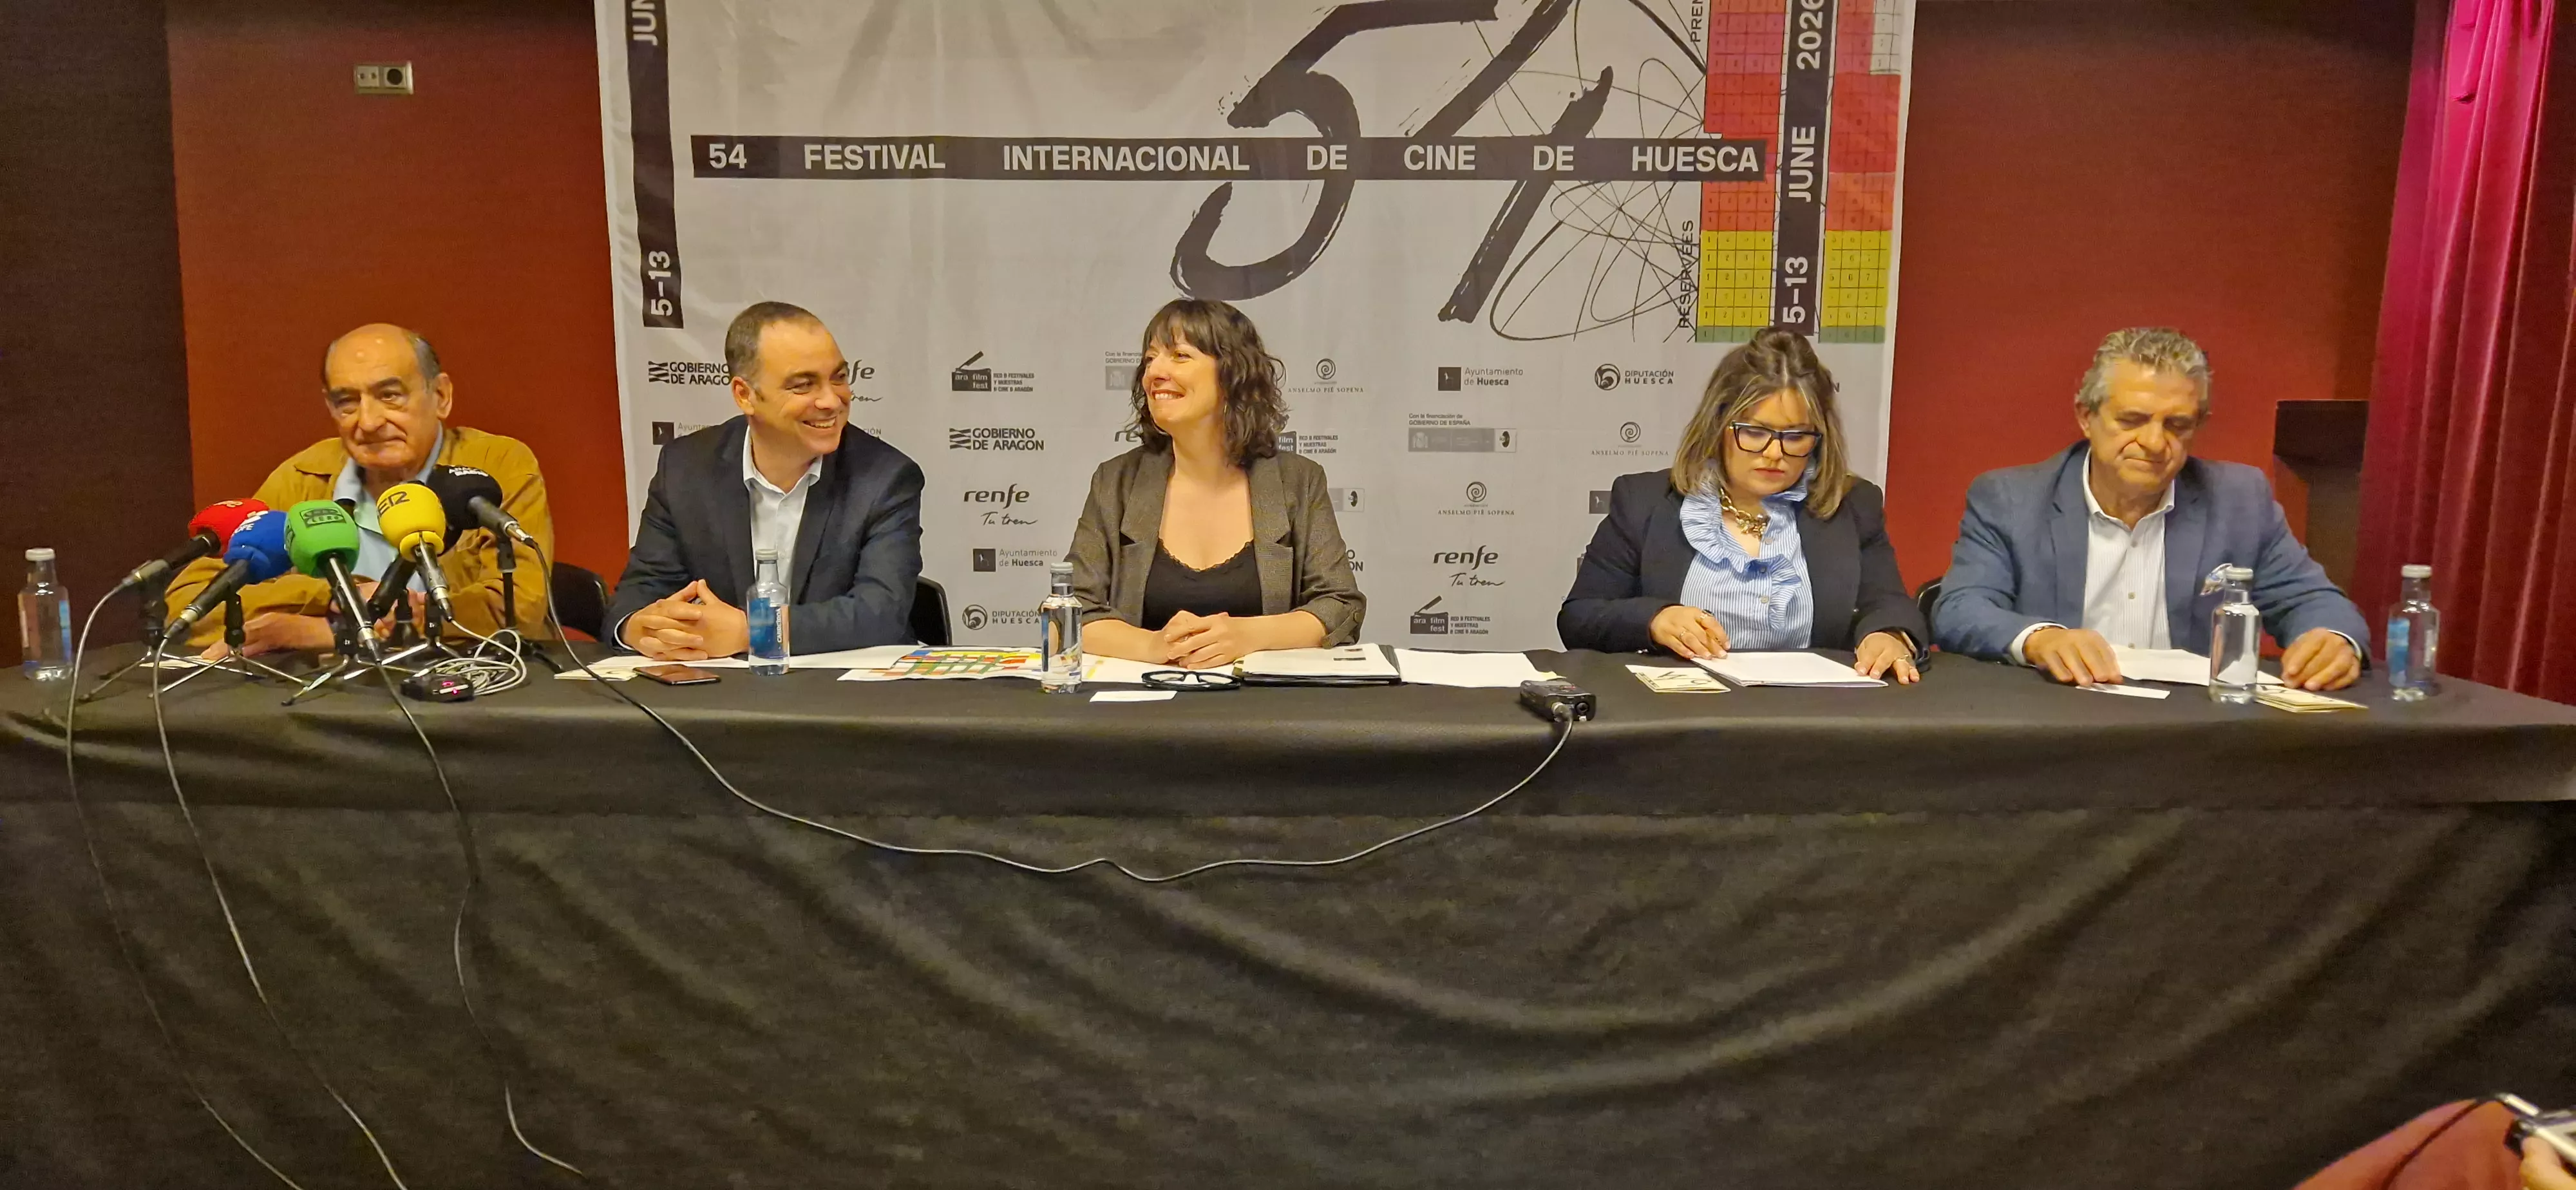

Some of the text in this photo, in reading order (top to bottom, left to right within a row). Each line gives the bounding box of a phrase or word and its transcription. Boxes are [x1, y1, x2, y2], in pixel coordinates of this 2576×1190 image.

[708, 144, 1759, 172] 54 FESTIVAL INTERNACIONAL DE CINE DE HUESCA
[1788, 126, 1816, 202] JUNE
[650, 250, 673, 316] 5-13
[1783, 256, 1808, 324] 5-13
[1464, 367, 1524, 377] Ayuntamiento
[1625, 369, 1674, 377] DIPUTACIÓN
[670, 374, 732, 385] DE ARAGO
[1464, 377, 1509, 386] de Huesca
[972, 428, 1035, 439] GOBIERNO
[973, 440, 989, 450] DE
[963, 484, 1030, 509] renfe
[999, 549, 1057, 558] Ayuntamiento
[1433, 545, 1499, 570] renfe
[1012, 558, 1044, 567] Huesca
